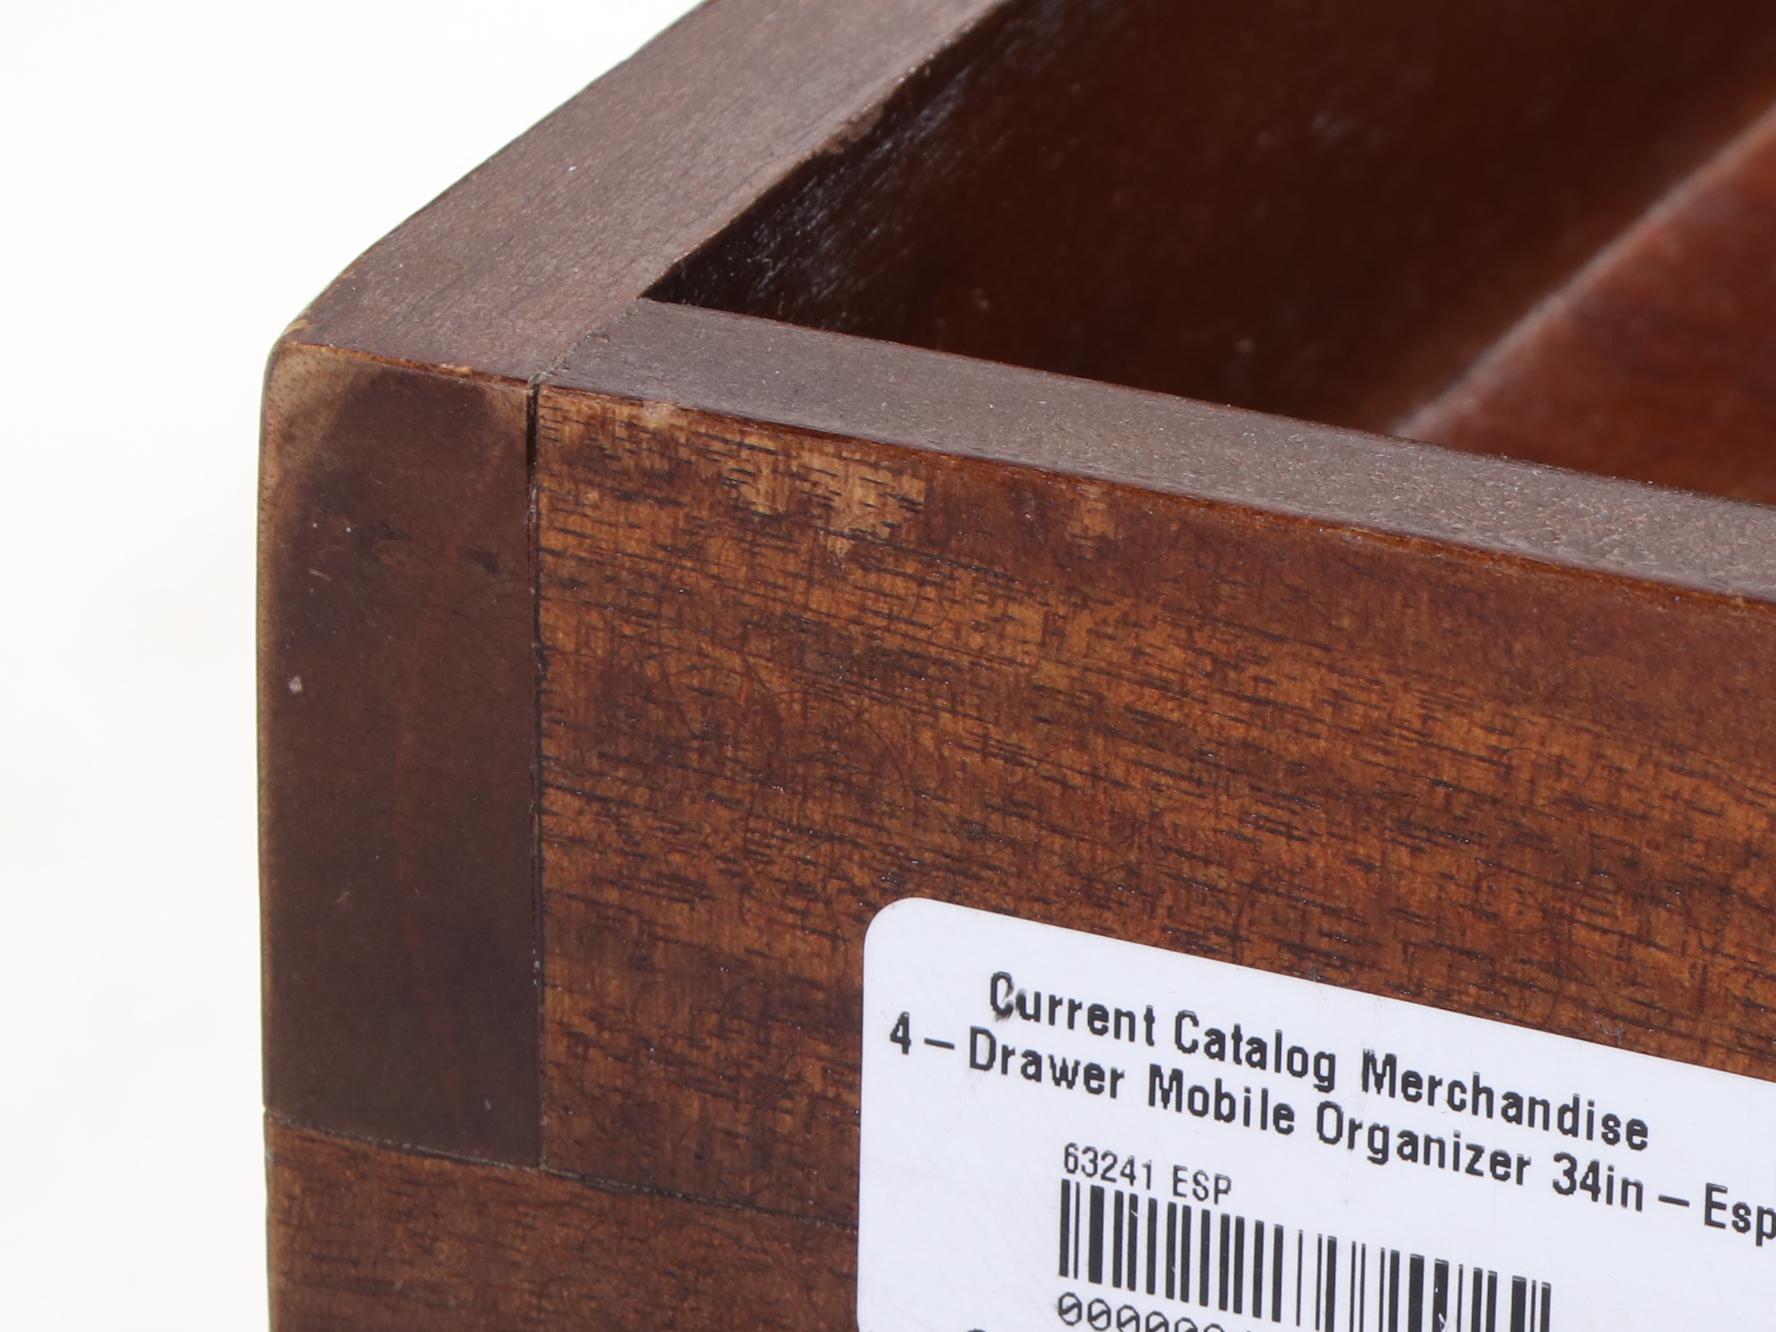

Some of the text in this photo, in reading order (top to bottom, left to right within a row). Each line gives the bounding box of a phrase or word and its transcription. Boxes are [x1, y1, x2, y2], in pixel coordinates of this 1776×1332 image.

[989, 971, 1649, 1151] Current Catalog Merchandise
[1063, 1142, 1232, 1205] 63241 ESP
[1147, 1063, 1295, 1135] Mobile
[1316, 1101, 1531, 1186] Organizer
